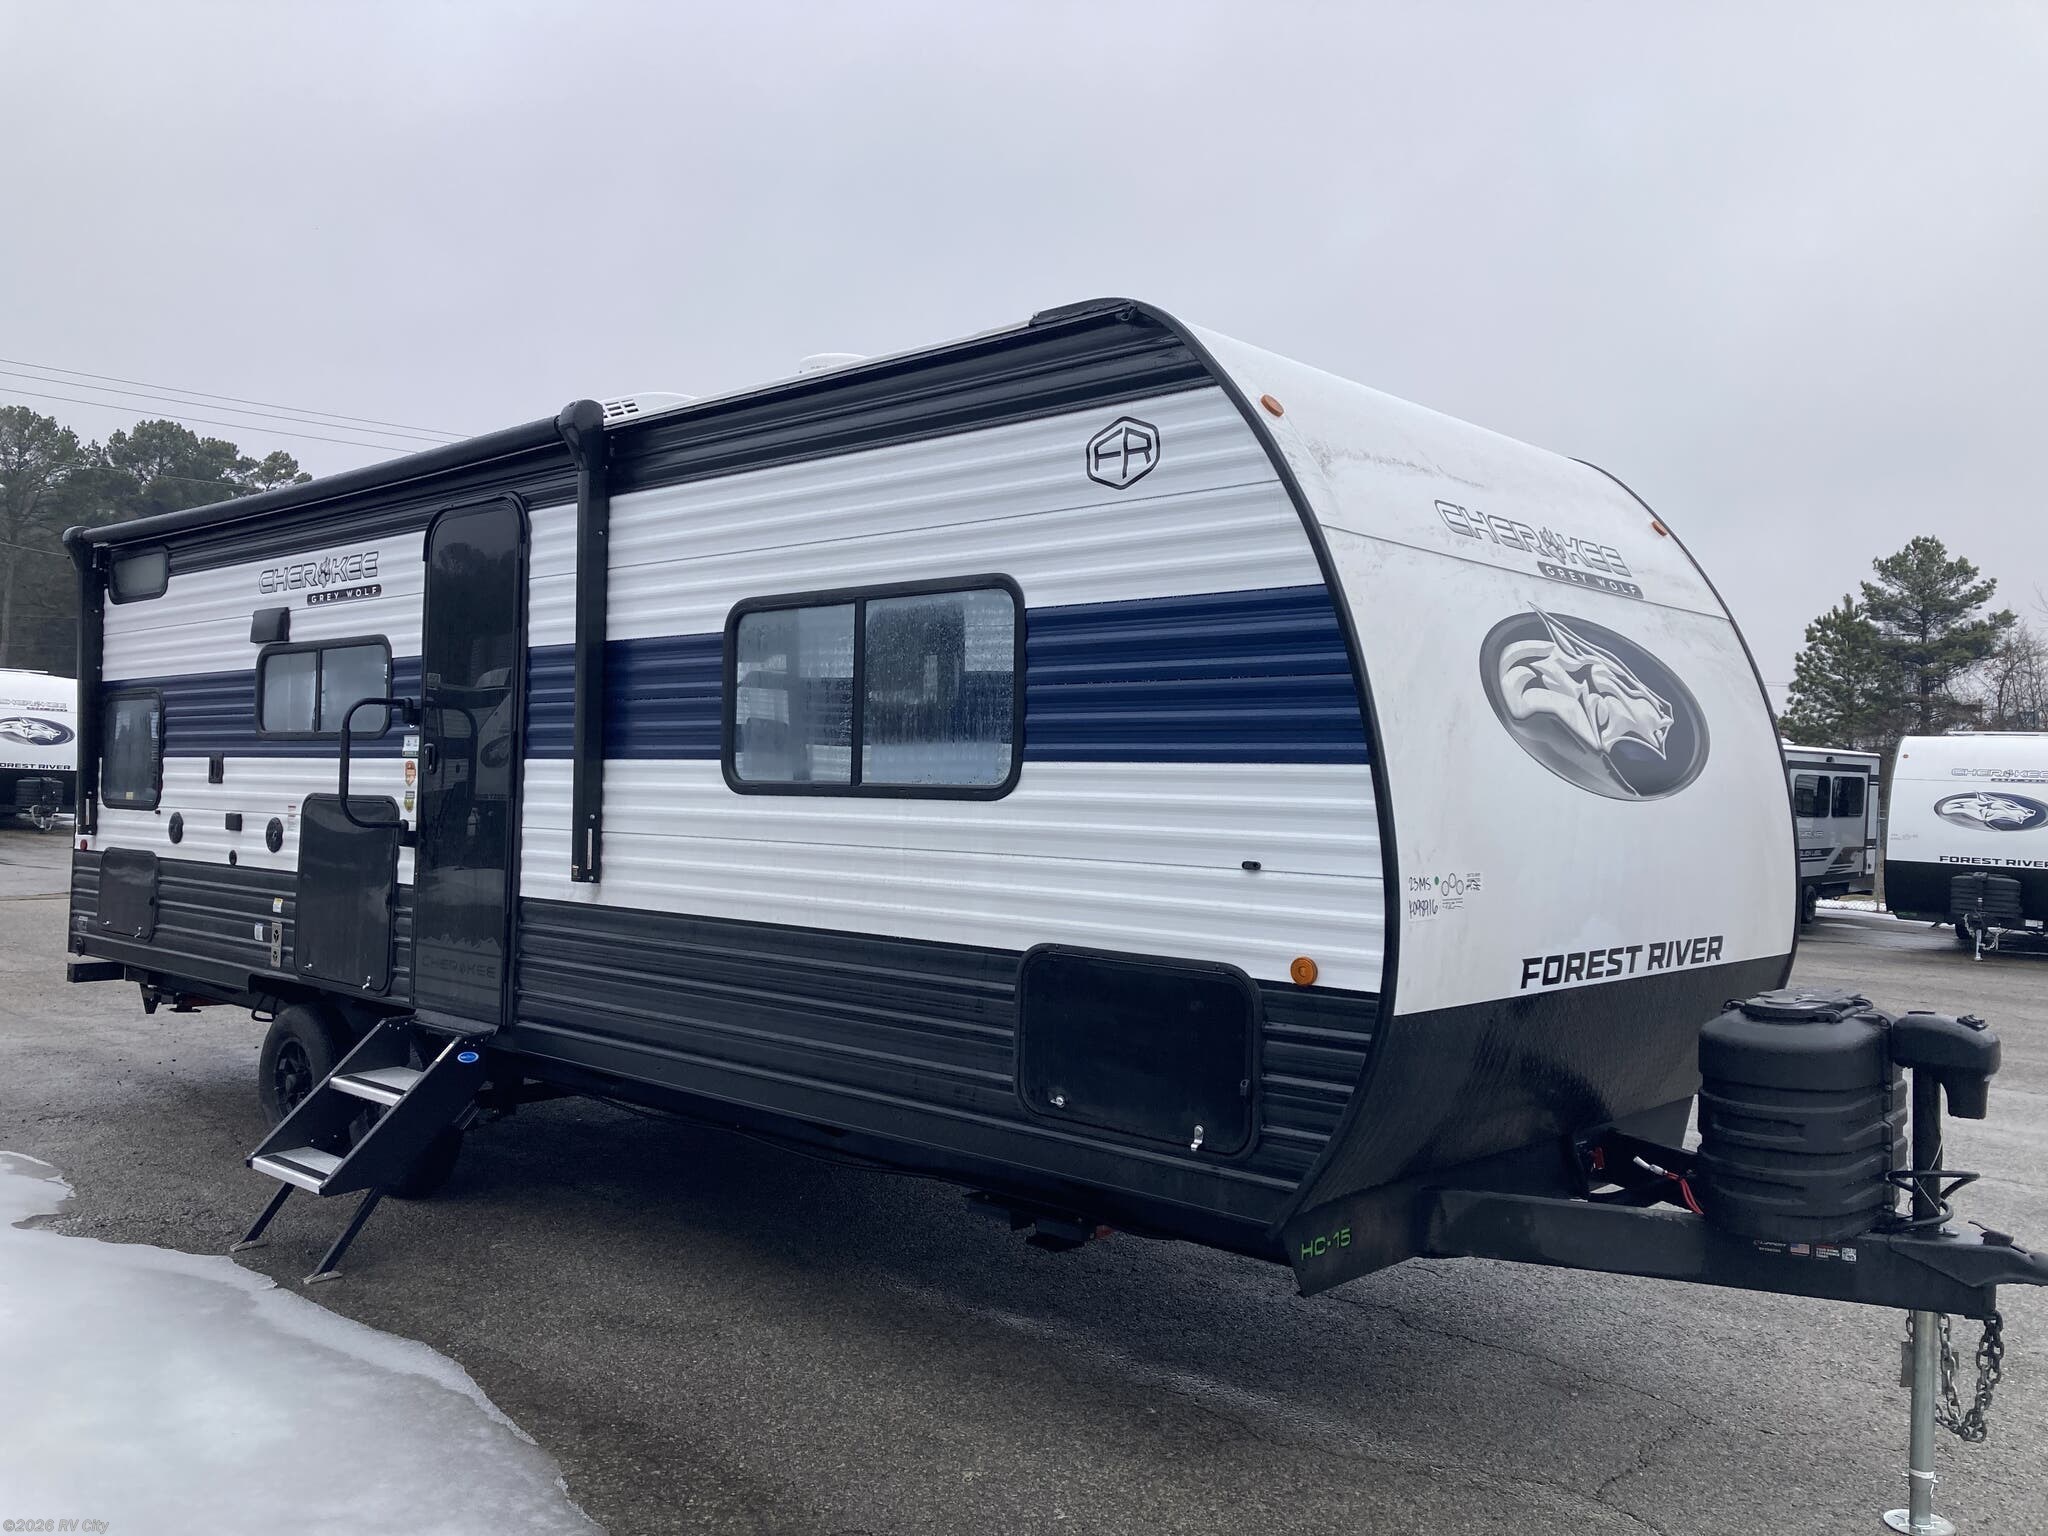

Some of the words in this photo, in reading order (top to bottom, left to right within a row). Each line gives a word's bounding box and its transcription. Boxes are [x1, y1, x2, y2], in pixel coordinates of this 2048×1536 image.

[1434, 499, 1632, 577] CHEROKEE
[258, 551, 379, 594] CHEROKEE
[1545, 565, 1588, 583] GREY
[1596, 578, 1638, 595] WOLF
[311, 591, 339, 604] GREY
[346, 586, 378, 598] WOLF
[1939, 855, 2001, 865] FOREST
[1520, 944, 1643, 989] FOREST
[1647, 935, 1723, 971] RIVER
